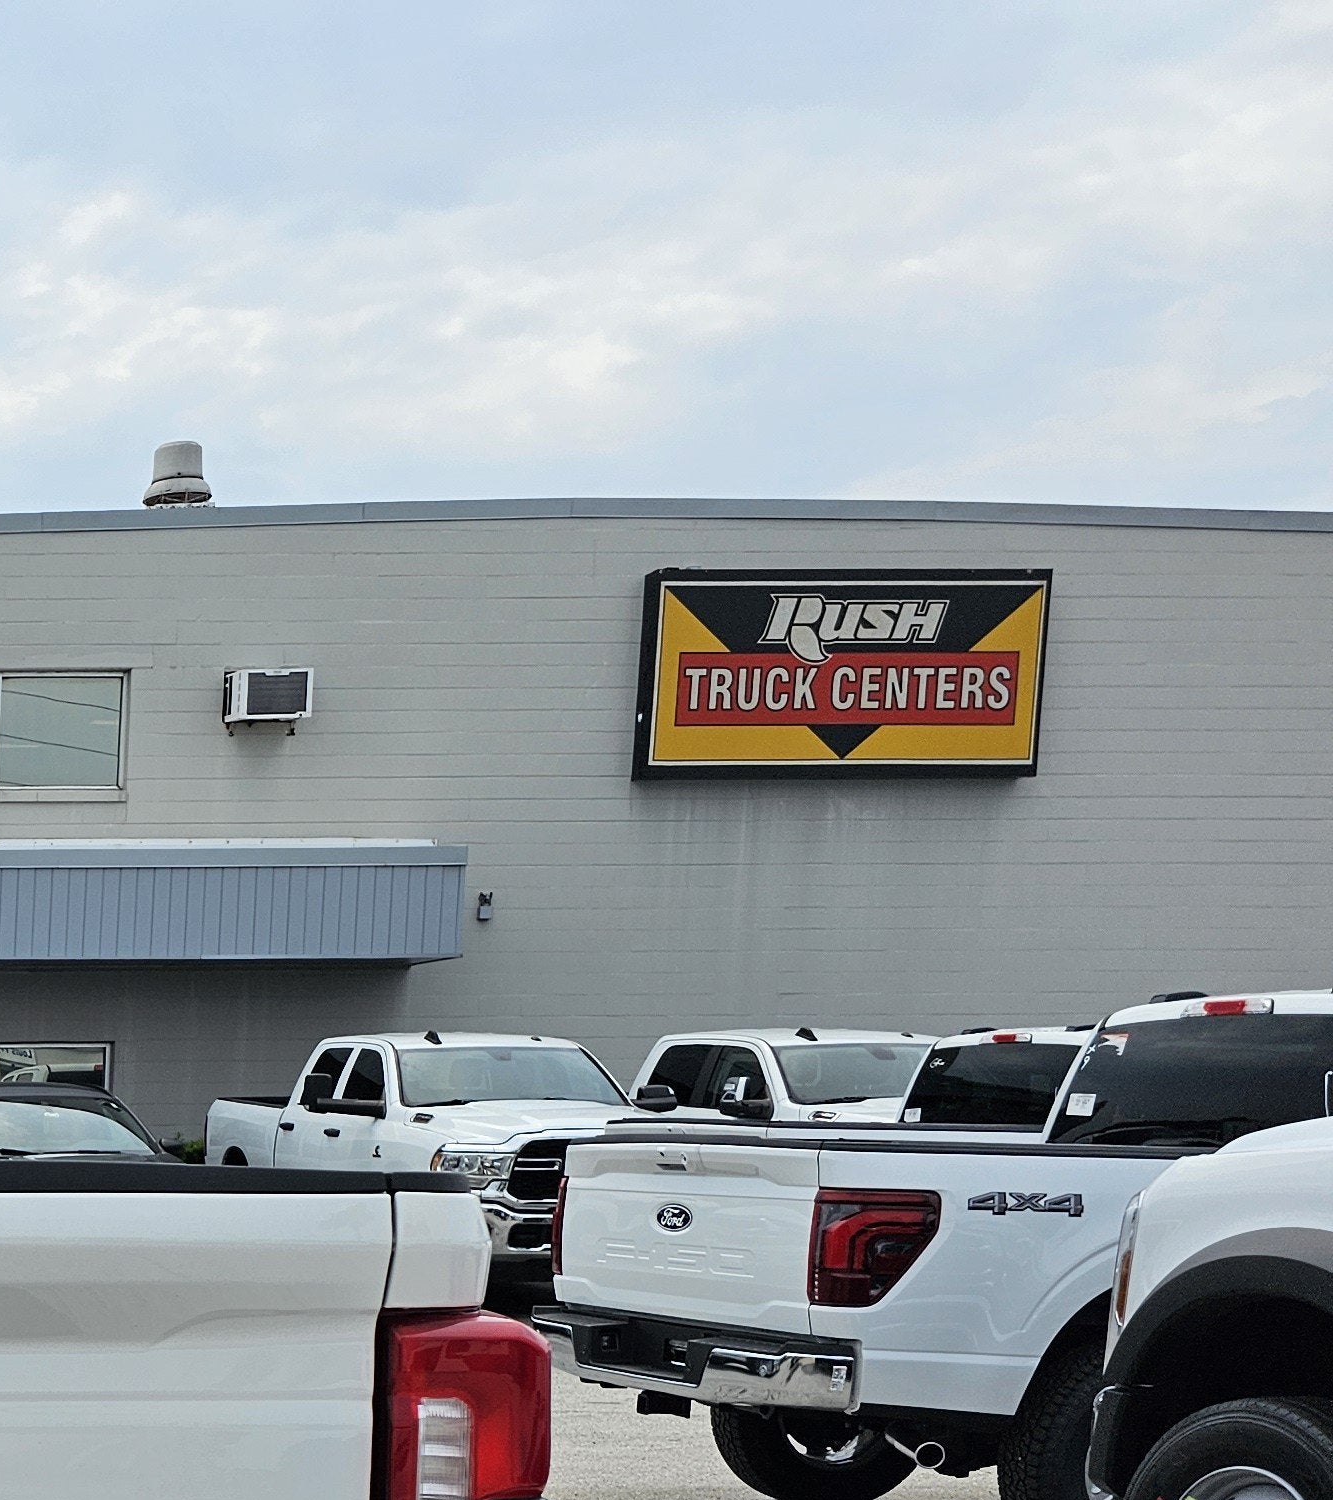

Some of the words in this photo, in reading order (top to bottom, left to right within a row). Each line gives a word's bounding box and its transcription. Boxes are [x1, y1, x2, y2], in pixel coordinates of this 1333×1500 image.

[685, 666, 820, 711] TRUCK
[831, 665, 1012, 711] CENTERS
[660, 1207, 686, 1227] Ford
[597, 1237, 756, 1279] F-150
